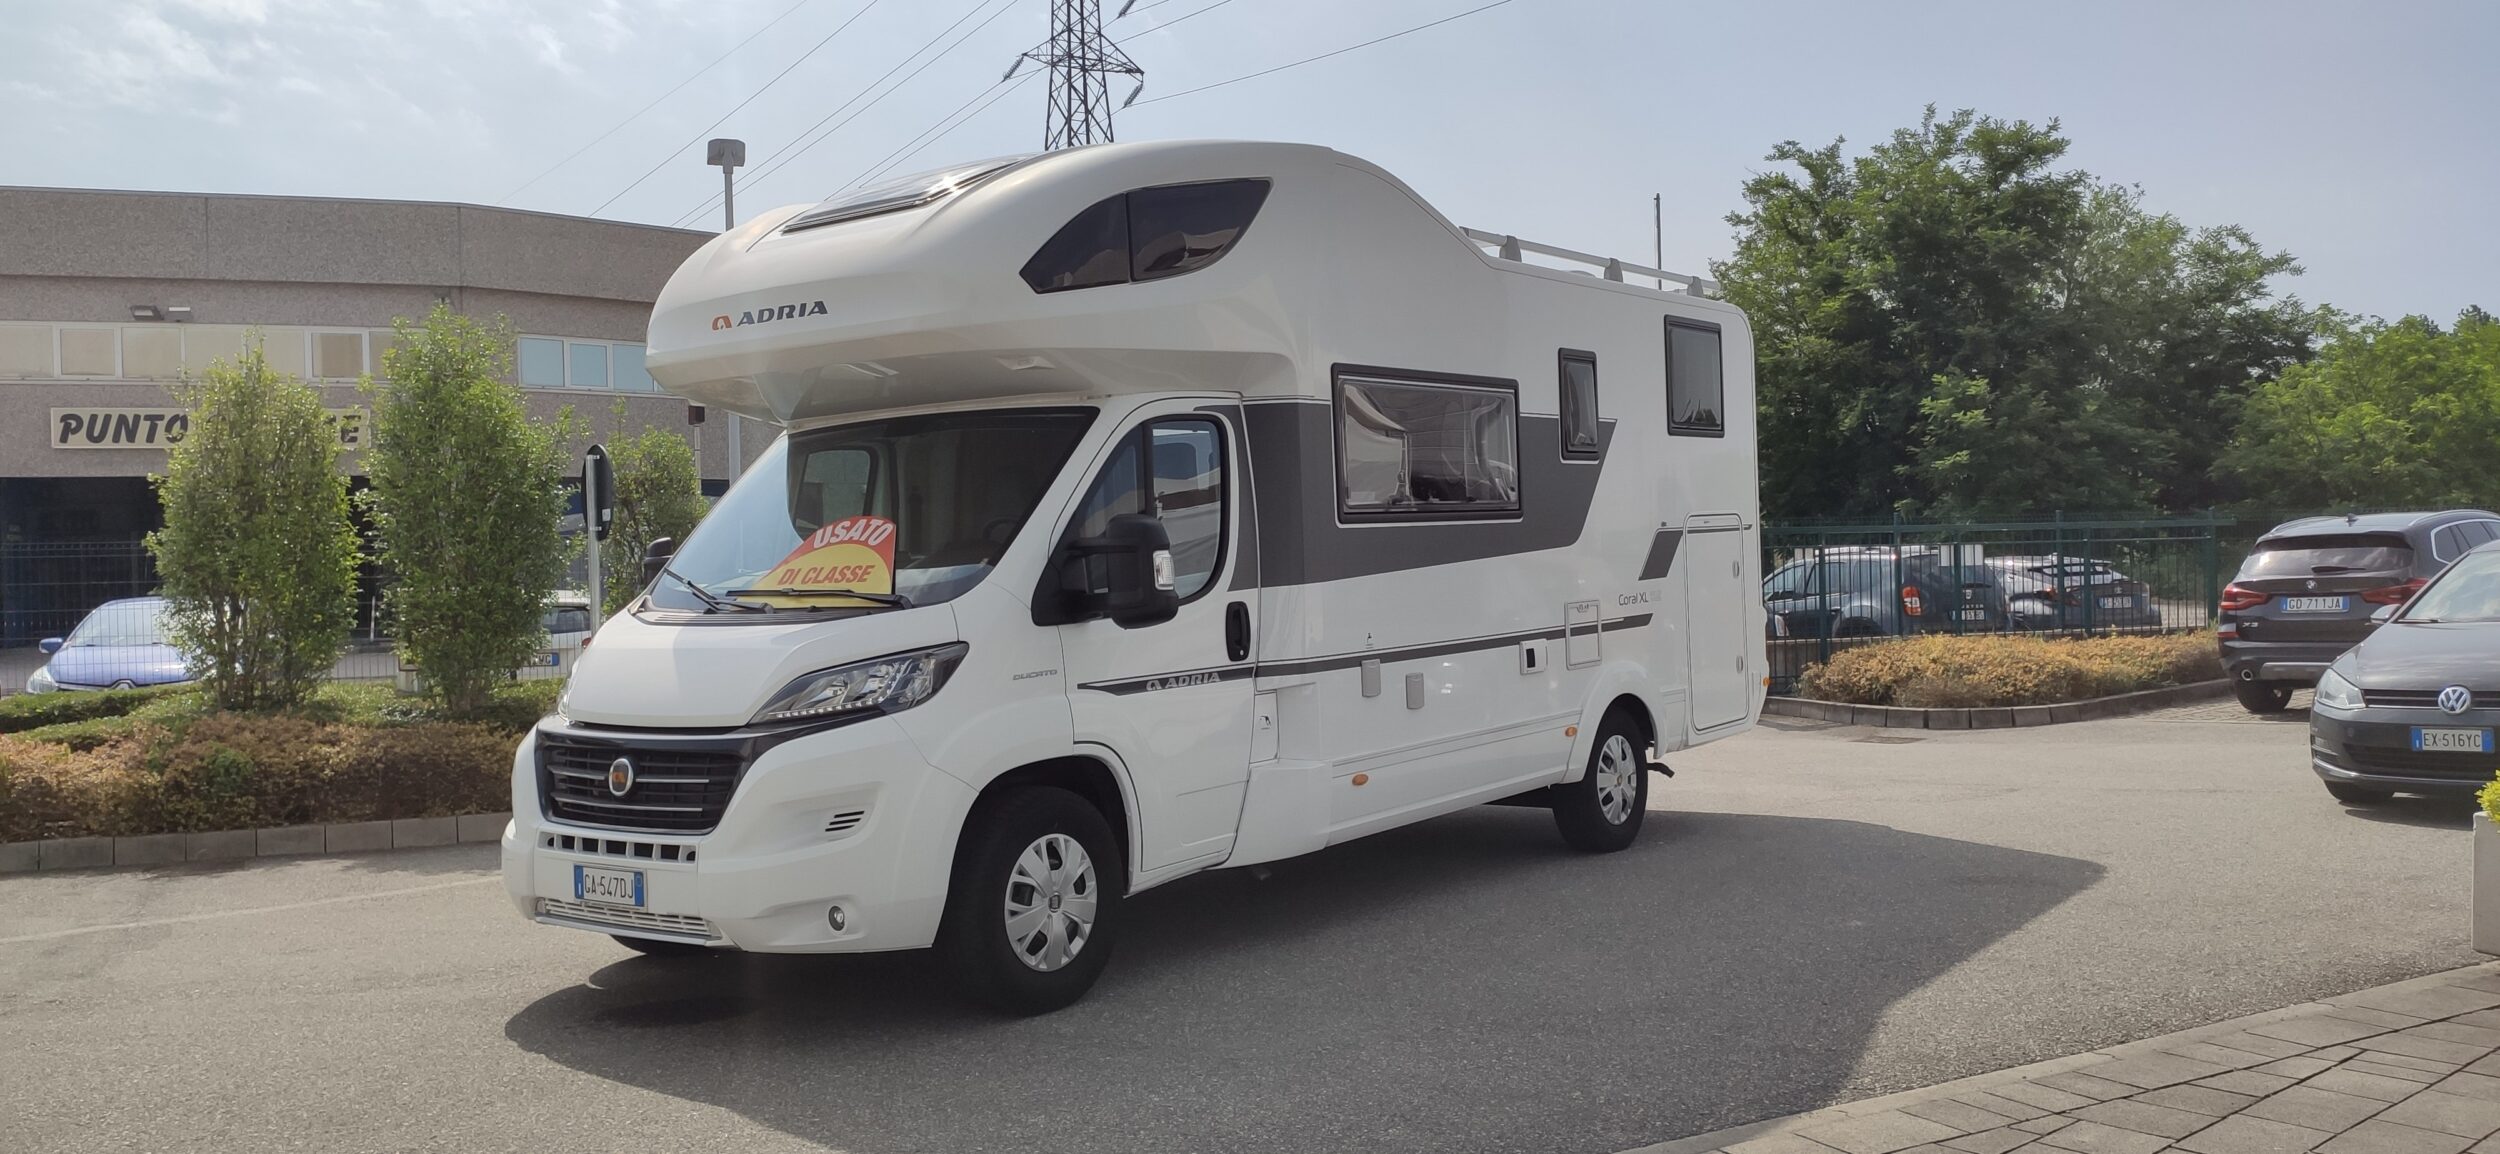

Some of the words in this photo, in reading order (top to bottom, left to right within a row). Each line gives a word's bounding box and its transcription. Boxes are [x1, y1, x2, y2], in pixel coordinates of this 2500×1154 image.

[736, 300, 828, 327] ADRIA
[59, 413, 189, 444] PUNTO
[813, 518, 894, 549] USATO
[777, 567, 799, 586] DI
[801, 564, 876, 585] CLASSE
[1618, 592, 1638, 606] Coral
[1639, 591, 1649, 604] XL
[1164, 672, 1221, 690] ADRIA
